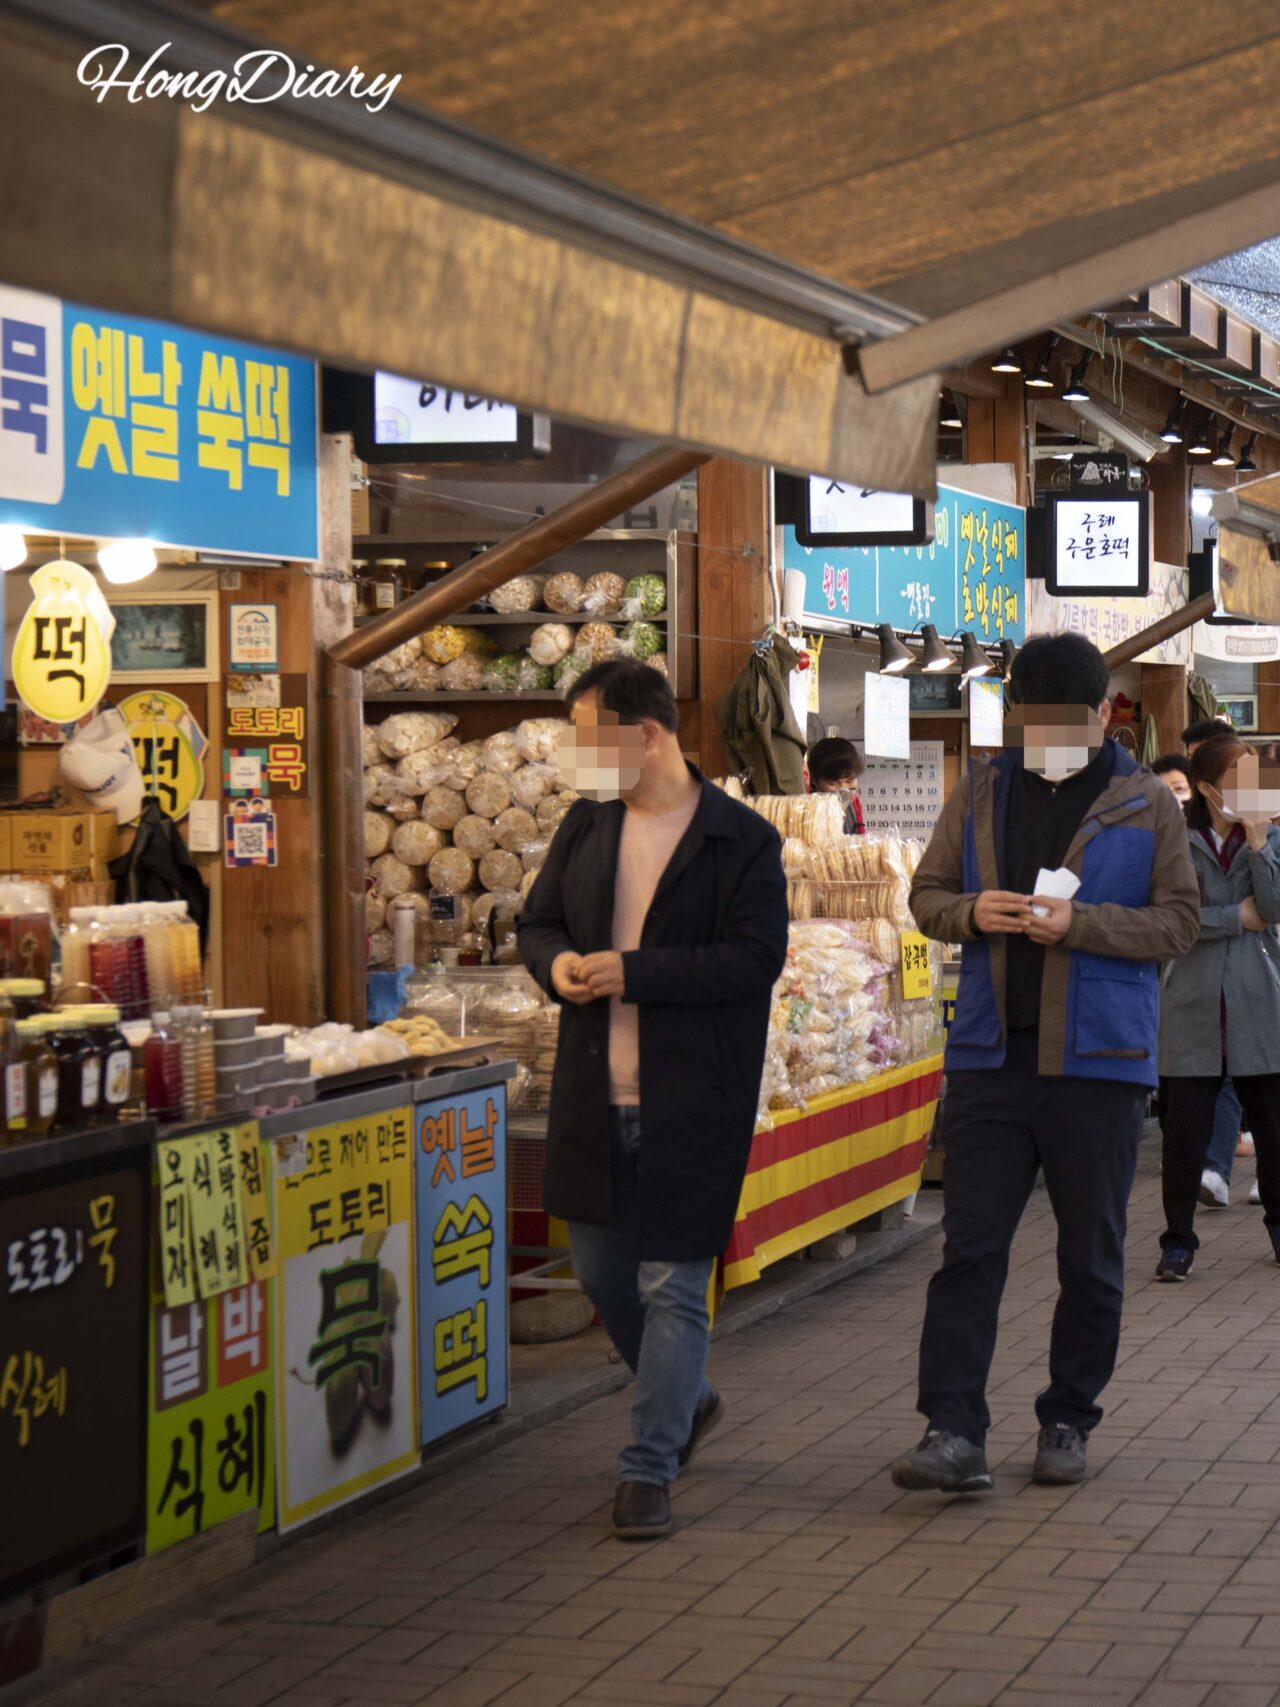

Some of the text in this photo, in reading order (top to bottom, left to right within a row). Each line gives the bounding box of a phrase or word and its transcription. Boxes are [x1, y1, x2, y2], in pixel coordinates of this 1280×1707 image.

[71, 321, 290, 497] 옛날 쑥떡
[1081, 513, 1116, 533] 구례
[822, 562, 850, 613] 원액
[33, 616, 87, 703] 떡
[227, 706, 305, 741] 도토리
[266, 743, 306, 792] 묵
[377, 1119, 407, 1164] 만든
[420, 1097, 499, 1190] 옛날
[88, 1194, 118, 1288] 묵
[163, 1149, 188, 1289] 오미자
[193, 1152, 220, 1274] 식혜
[307, 1179, 391, 1253] 도토리
[308, 1258, 388, 1391] 묵
[157, 1389, 267, 1533] 식혜
